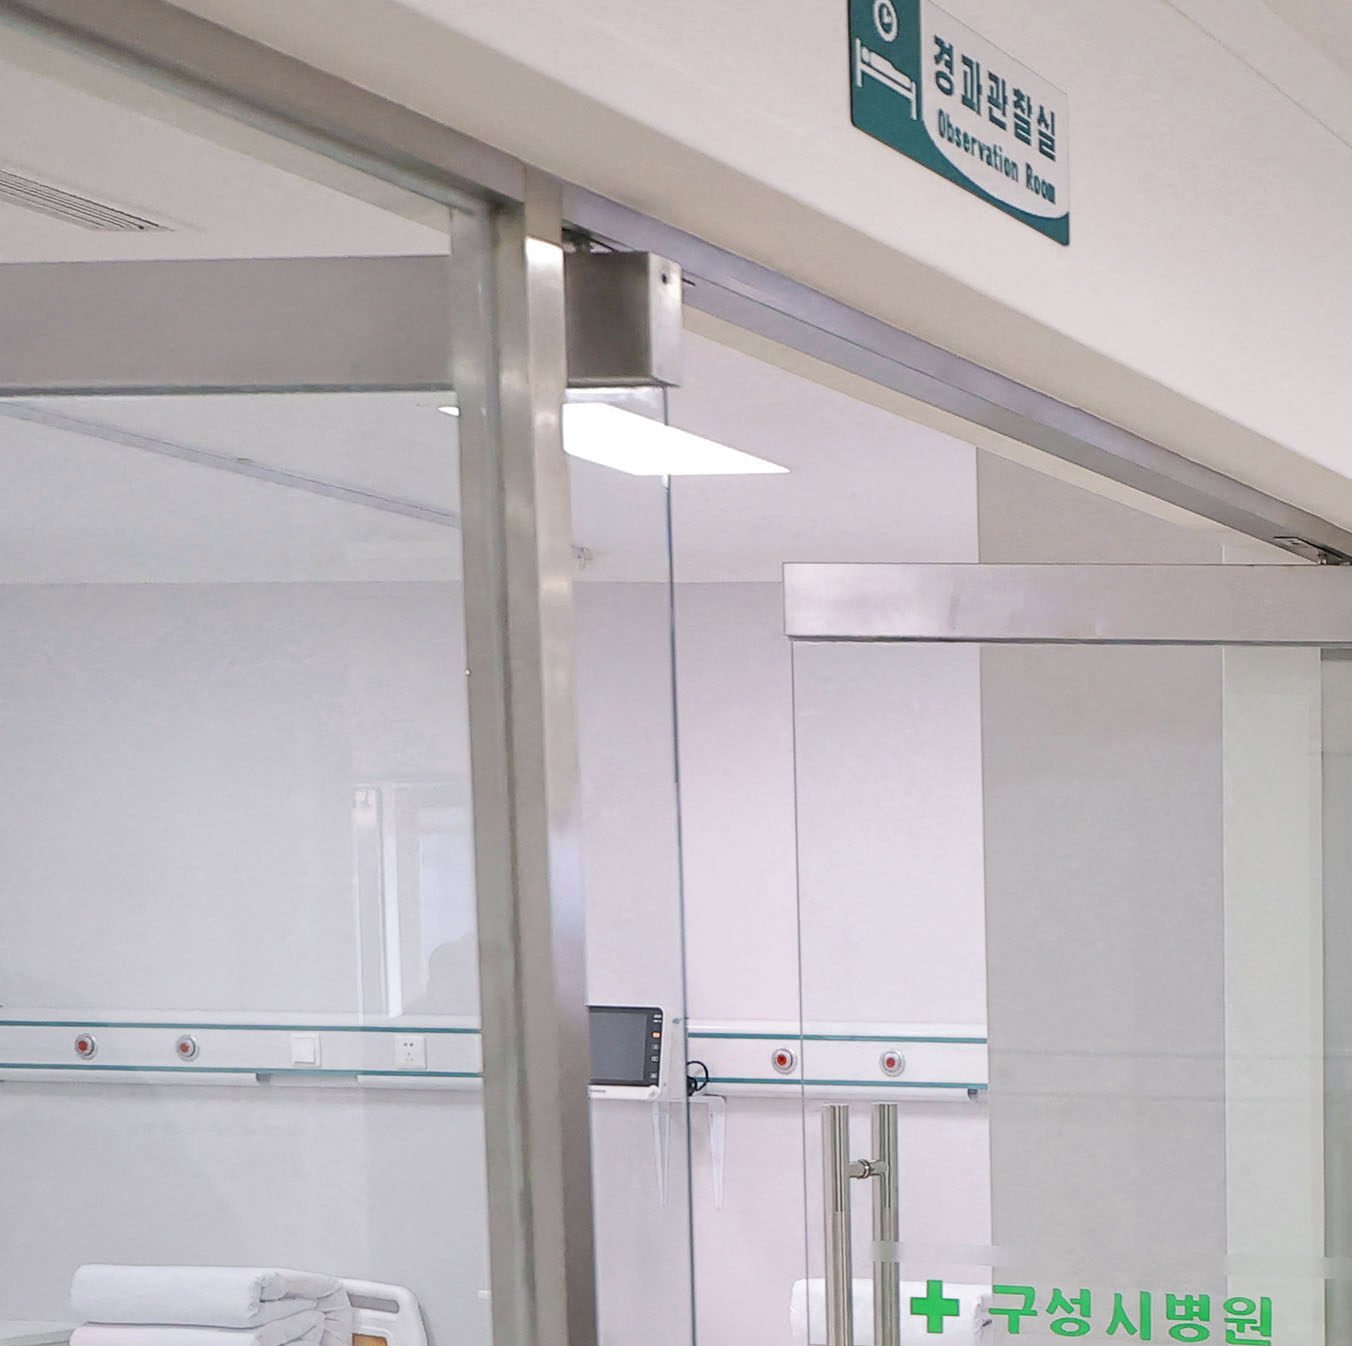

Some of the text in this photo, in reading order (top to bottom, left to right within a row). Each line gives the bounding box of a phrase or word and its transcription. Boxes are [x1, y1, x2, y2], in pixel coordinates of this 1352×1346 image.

[934, 35, 1056, 162] 경과관찰실
[938, 108, 1056, 204] Observation Room
